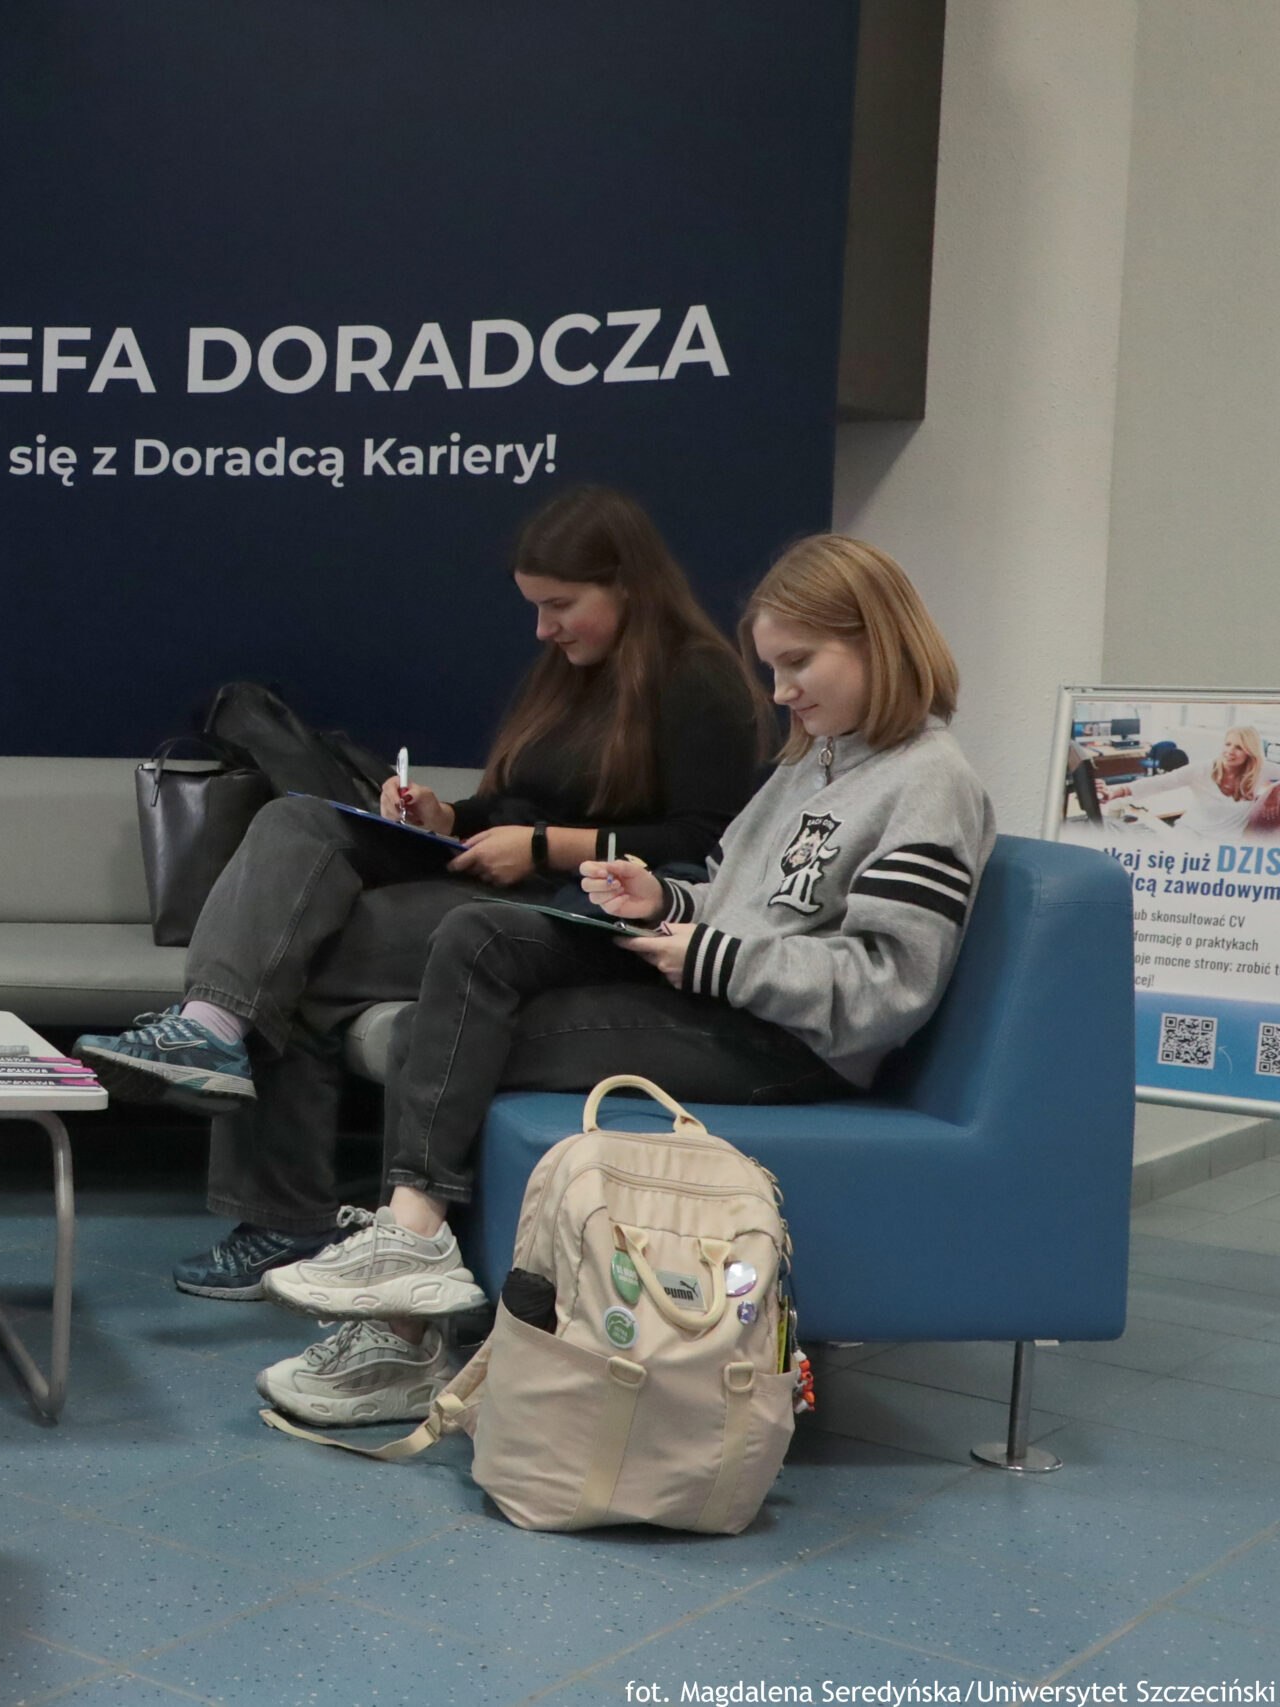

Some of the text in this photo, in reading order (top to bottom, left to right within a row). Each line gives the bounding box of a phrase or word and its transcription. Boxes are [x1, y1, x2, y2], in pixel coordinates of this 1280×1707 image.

[187, 304, 730, 395] DORADCZA
[8, 434, 78, 488] się
[93, 446, 117, 476] z
[134, 437, 345, 488] Doradcą
[363, 432, 558, 485] Kariery!
[1148, 851, 1175, 875] się
[1181, 852, 1211, 874] już
[1164, 878, 1280, 903] zawodowym
[1134, 909, 1246, 928] ub skonsultować CV
[1134, 930, 1259, 952] formację o praktykach
[1134, 953, 1151, 966] oje
[1154, 954, 1191, 968] mocne
[1236, 961, 1271, 975] zrobić
[1134, 974, 1155, 988] cej!
[664, 1287, 694, 1301] PUMA
